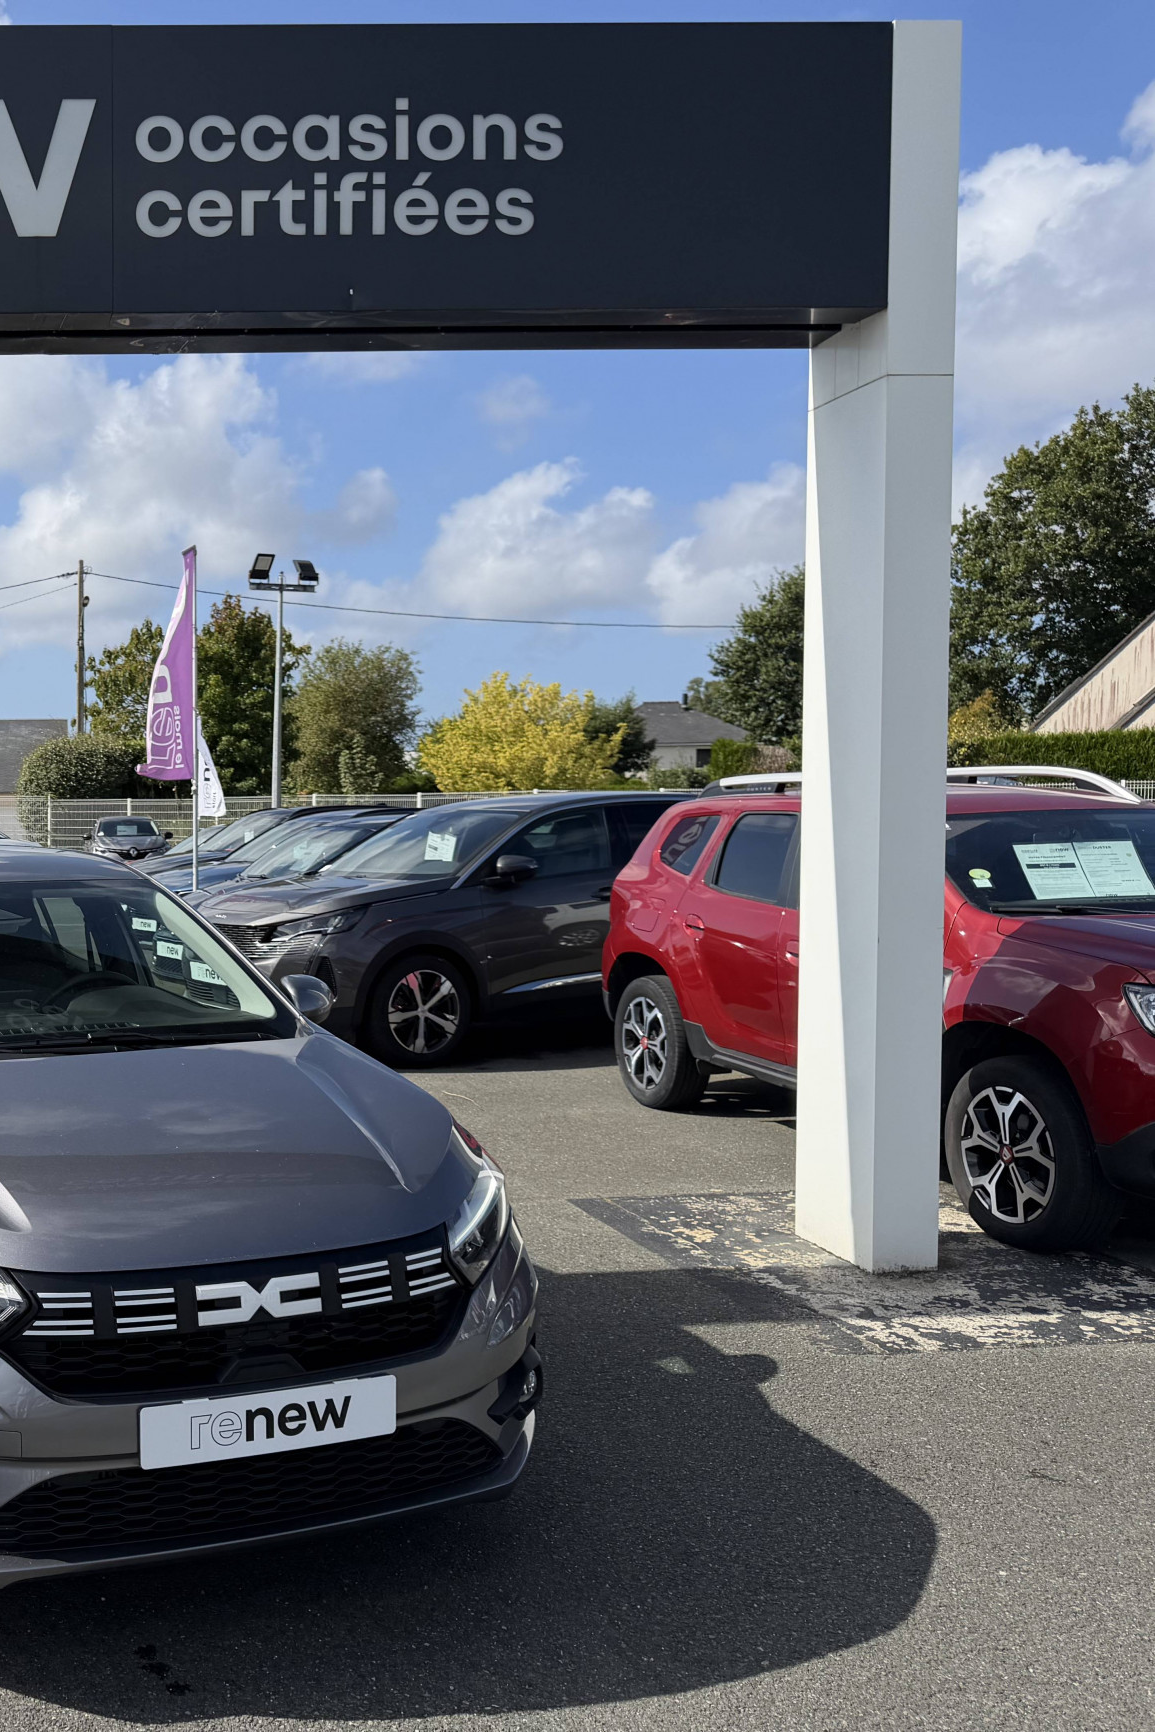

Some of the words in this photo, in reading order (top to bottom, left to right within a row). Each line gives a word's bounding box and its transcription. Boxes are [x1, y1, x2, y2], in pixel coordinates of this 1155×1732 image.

[135, 97, 564, 163] occasions
[135, 171, 535, 238] certifiées
[189, 1395, 352, 1451] renew
